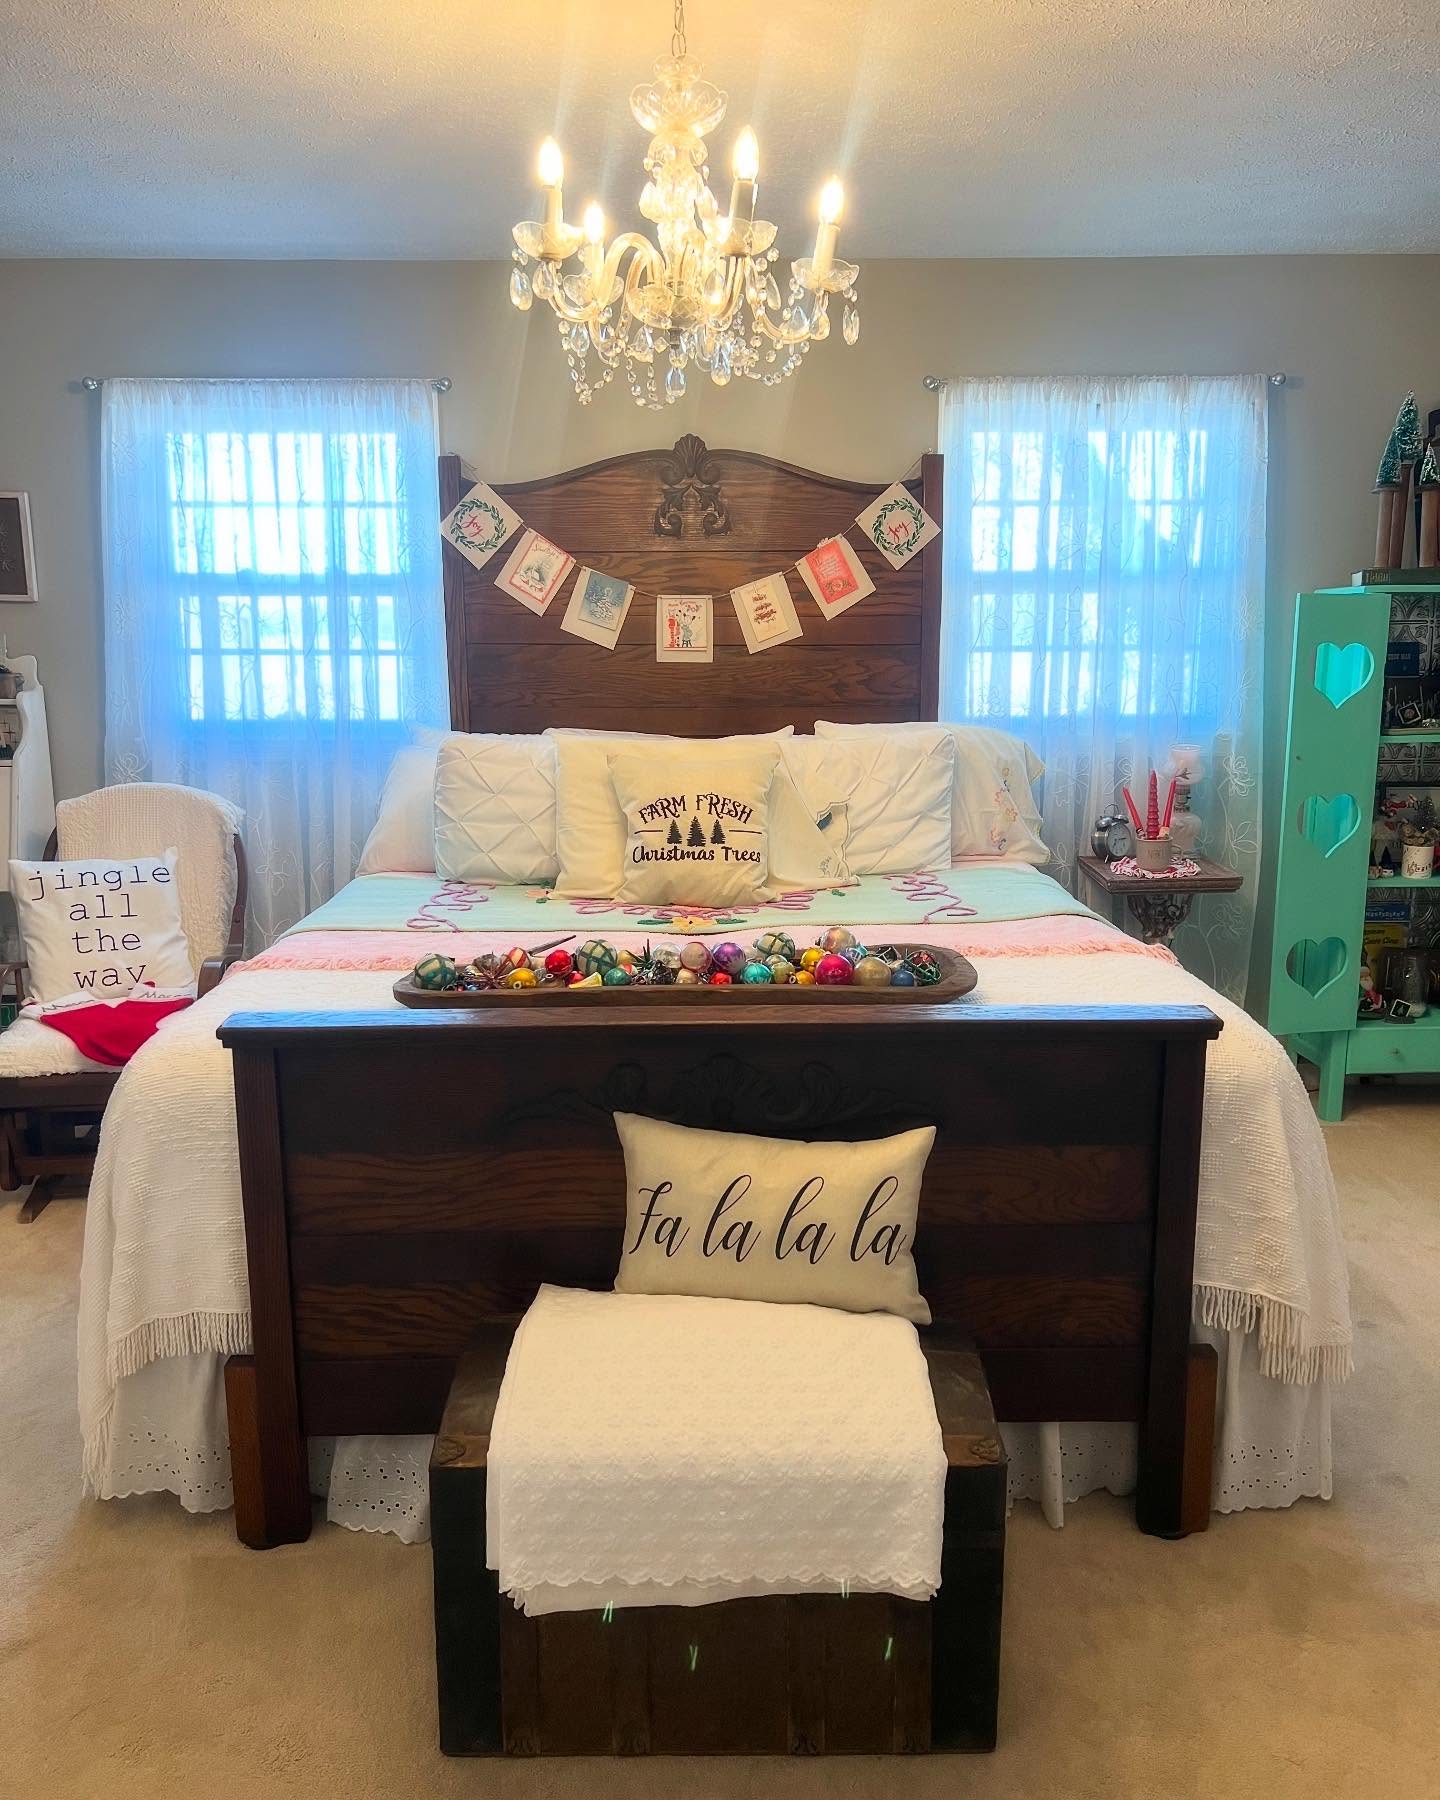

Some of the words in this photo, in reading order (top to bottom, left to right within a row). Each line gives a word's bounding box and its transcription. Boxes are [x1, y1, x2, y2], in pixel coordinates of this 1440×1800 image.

[638, 795, 687, 824] FARM
[696, 792, 754, 824] FRESH
[632, 846, 715, 863] Christmas
[721, 846, 761, 863] Trees
[29, 866, 170, 901] jingle
[69, 894, 138, 921] all
[72, 929, 141, 954] the
[73, 965, 146, 990] way
[629, 1181, 690, 1257] Fa
[702, 1174, 761, 1262] la
[775, 1176, 836, 1264] la
[850, 1176, 907, 1265] la
